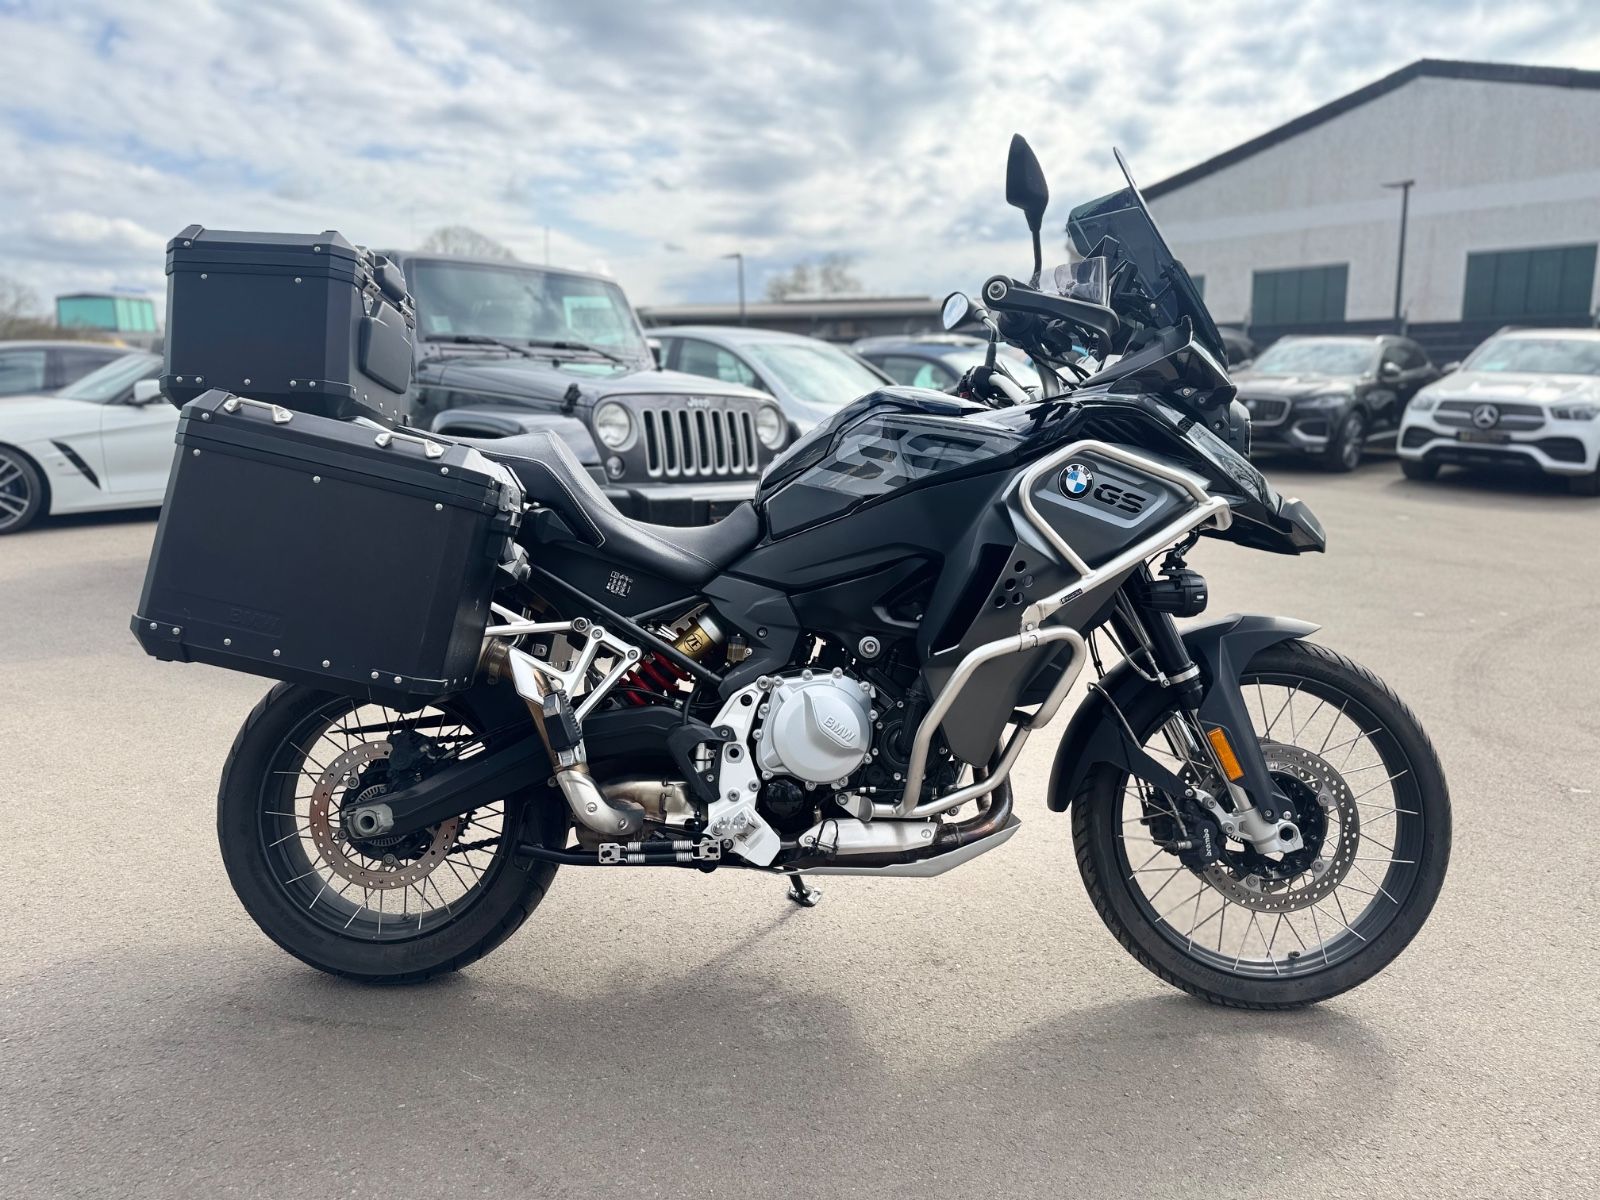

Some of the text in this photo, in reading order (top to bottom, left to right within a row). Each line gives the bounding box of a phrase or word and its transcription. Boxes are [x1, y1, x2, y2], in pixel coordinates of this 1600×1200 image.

[687, 397, 710, 409] Jeep
[1093, 483, 1147, 514] GS
[686, 633, 703, 652] ZF
[823, 715, 857, 743] BMW
[1202, 828, 1212, 857] brembo
